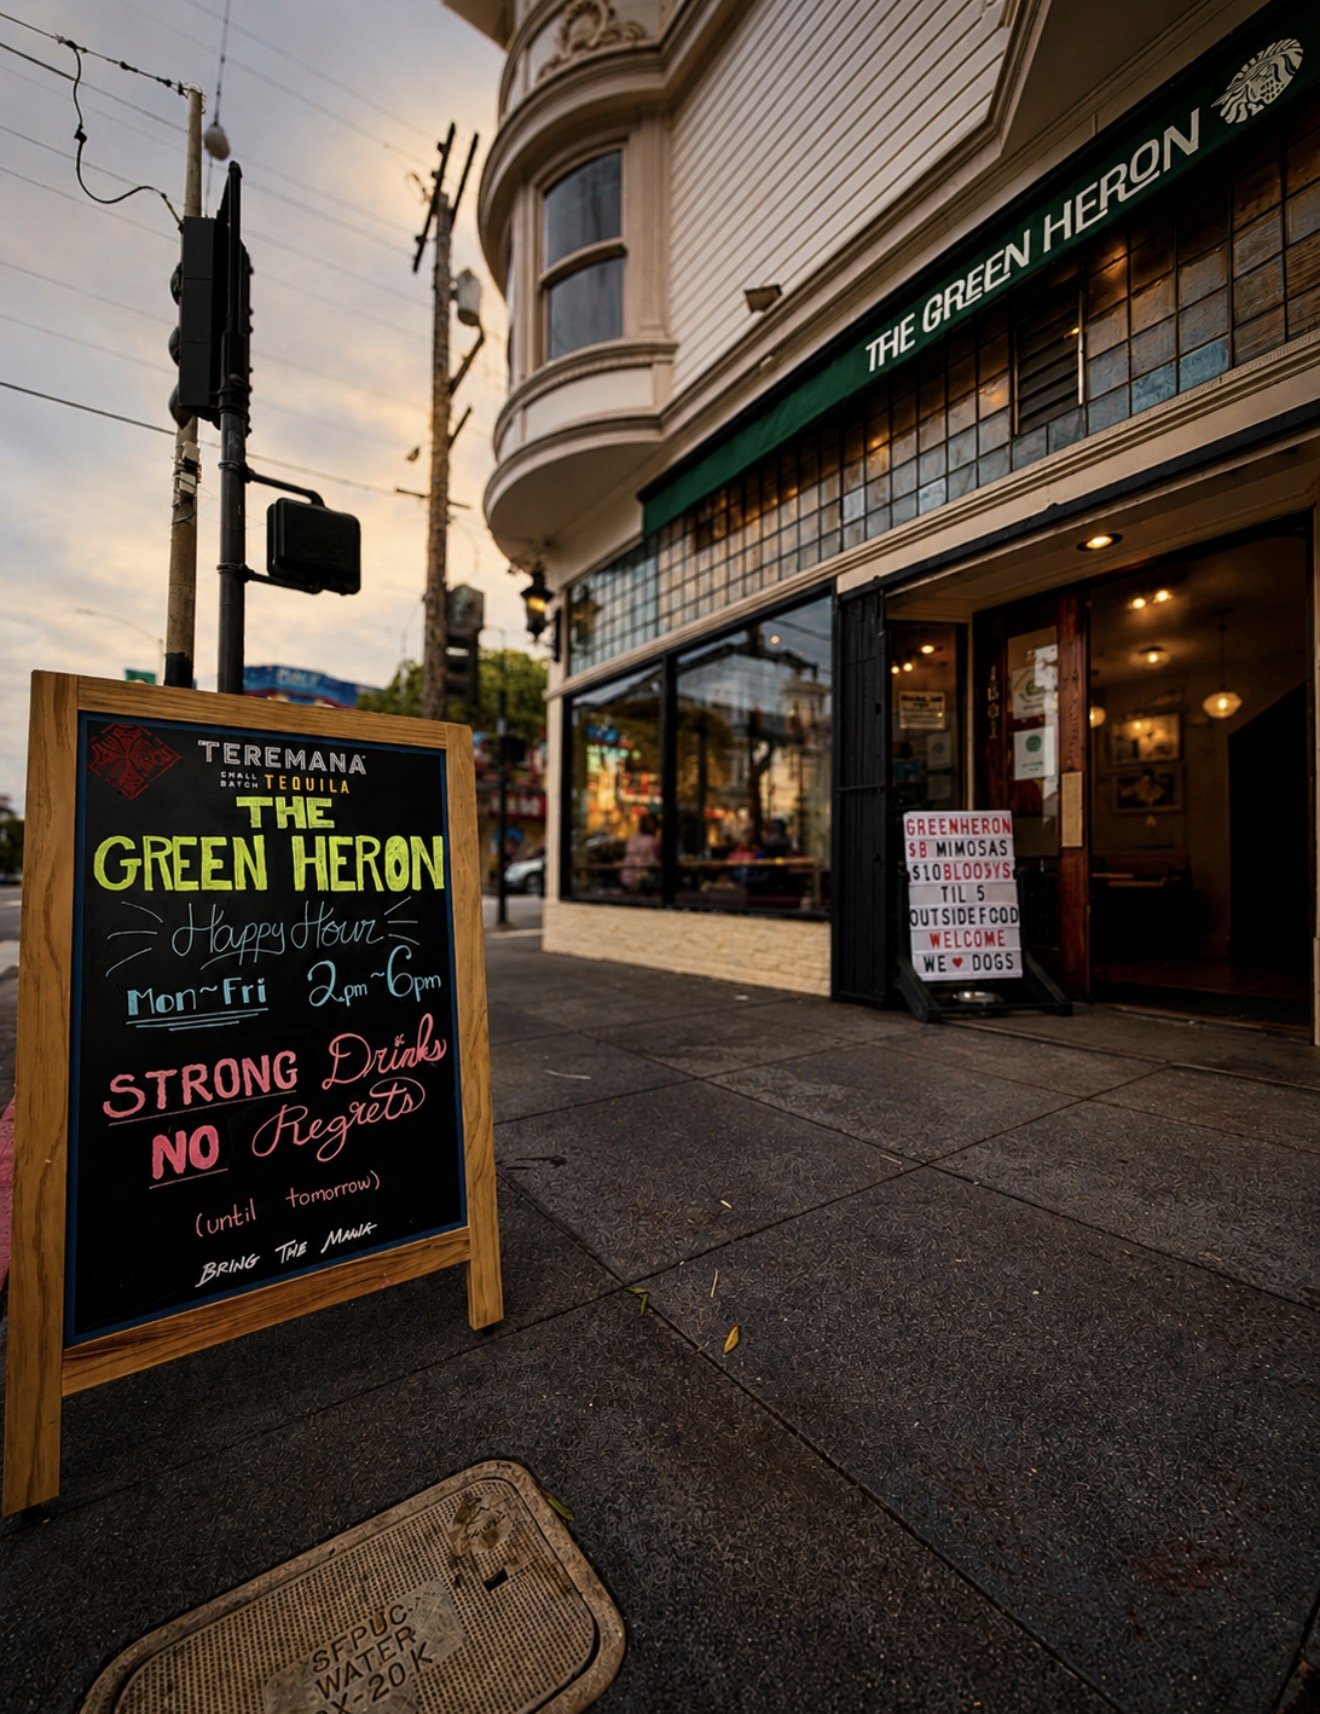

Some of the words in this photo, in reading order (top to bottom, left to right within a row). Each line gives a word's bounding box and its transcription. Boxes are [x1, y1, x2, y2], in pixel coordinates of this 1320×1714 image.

[865, 313, 916, 372] THE
[922, 229, 1031, 333] GREEN
[1043, 108, 1200, 253] HERON
[198, 739, 367, 776] TEREMANA
[220, 771, 257, 781] SMALL
[220, 780, 259, 789] BATCH
[264, 773, 350, 794] TEQUILA
[236, 796, 335, 829] THE
[93, 834, 268, 891] GREEN
[291, 835, 445, 891] HERON
[936, 839, 1008, 858] MIMOSAS
[941, 886, 966, 903] TIL
[976, 884, 985, 901] 5
[171, 901, 286, 966] Happy
[290, 900, 385, 949] Hour
[930, 929, 1006, 949] WELCOME
[923, 955, 947, 973] WE
[972, 952, 1014, 972] DOGS
[103, 1050, 298, 1119] STRONG
[321, 1013, 448, 1090] Drinks
[151, 1125, 220, 1180] NO
[251, 1077, 426, 1162] Regrets
[195, 1199, 257, 1238] (until
[286, 1170, 381, 1209] tomorrow)
[195, 1254, 261, 1288] BRING
[274, 1239, 308, 1264] THE
[312, 1603, 408, 1674] SFPUC
[315, 1625, 416, 1700] WATER
